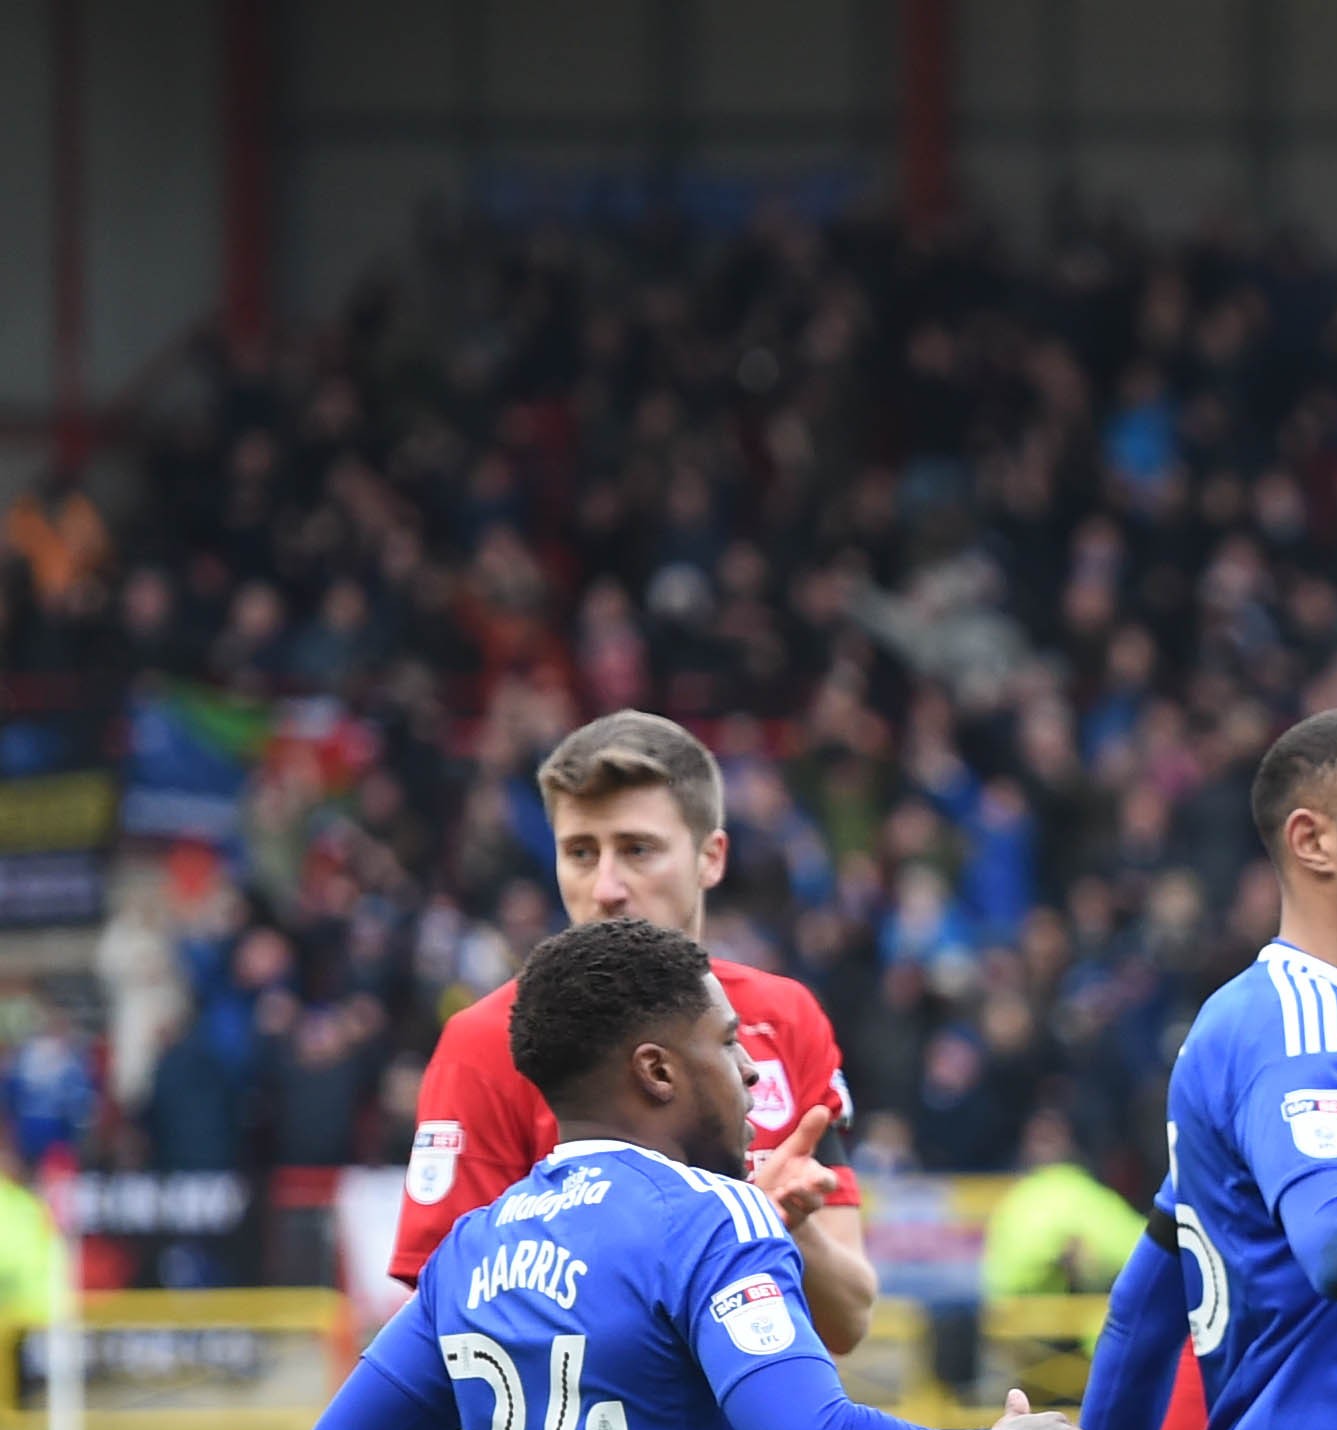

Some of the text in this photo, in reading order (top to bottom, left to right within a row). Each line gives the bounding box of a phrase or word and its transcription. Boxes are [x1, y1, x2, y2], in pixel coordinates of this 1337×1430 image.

[496, 1168, 612, 1227] Malaysia
[467, 1240, 588, 1310] HARRIS
[747, 1284, 780, 1300] BET
